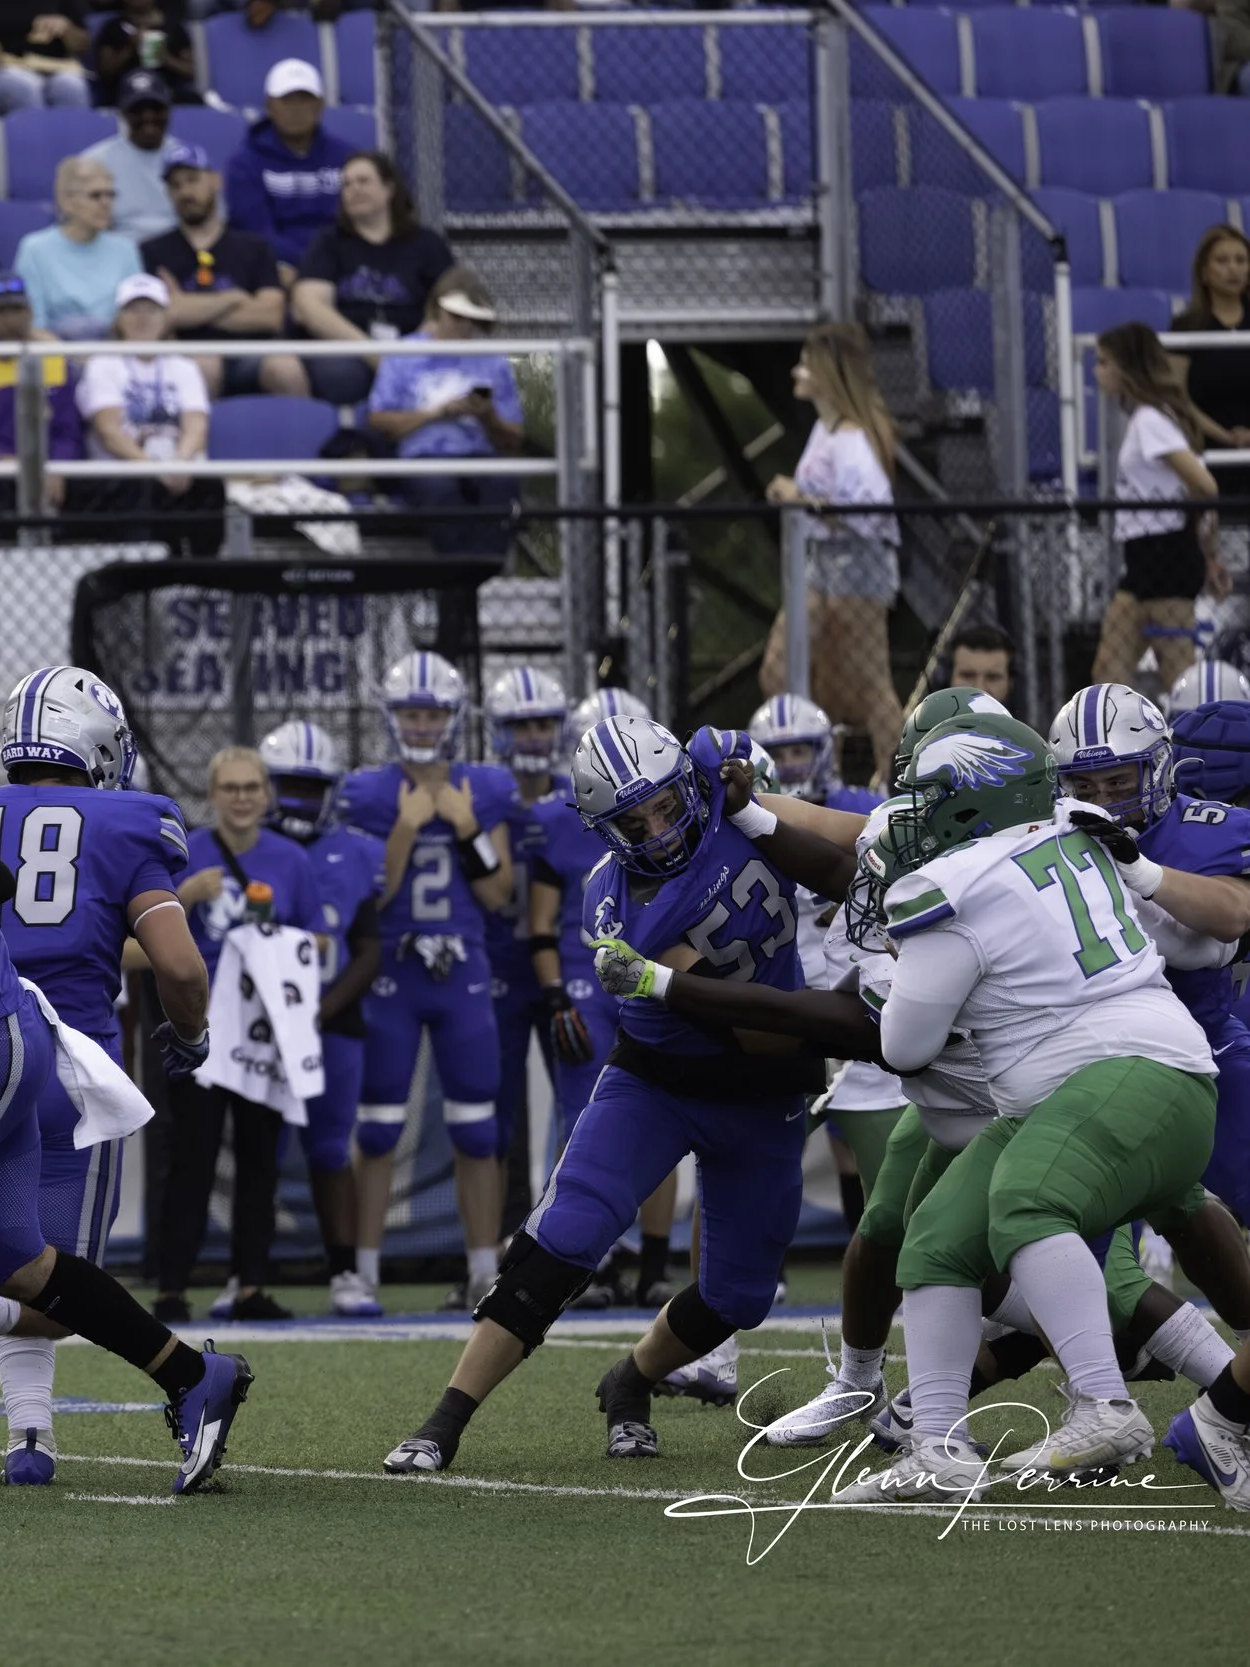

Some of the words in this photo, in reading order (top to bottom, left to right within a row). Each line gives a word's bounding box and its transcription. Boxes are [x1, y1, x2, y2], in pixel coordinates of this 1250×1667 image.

[26, 746, 65, 760] WAY
[1077, 749, 1108, 760] Vikings
[618, 780, 646, 799] Vikings
[412, 844, 451, 921] 2
[1010, 827, 1149, 980] 77
[686, 857, 796, 983] 53
